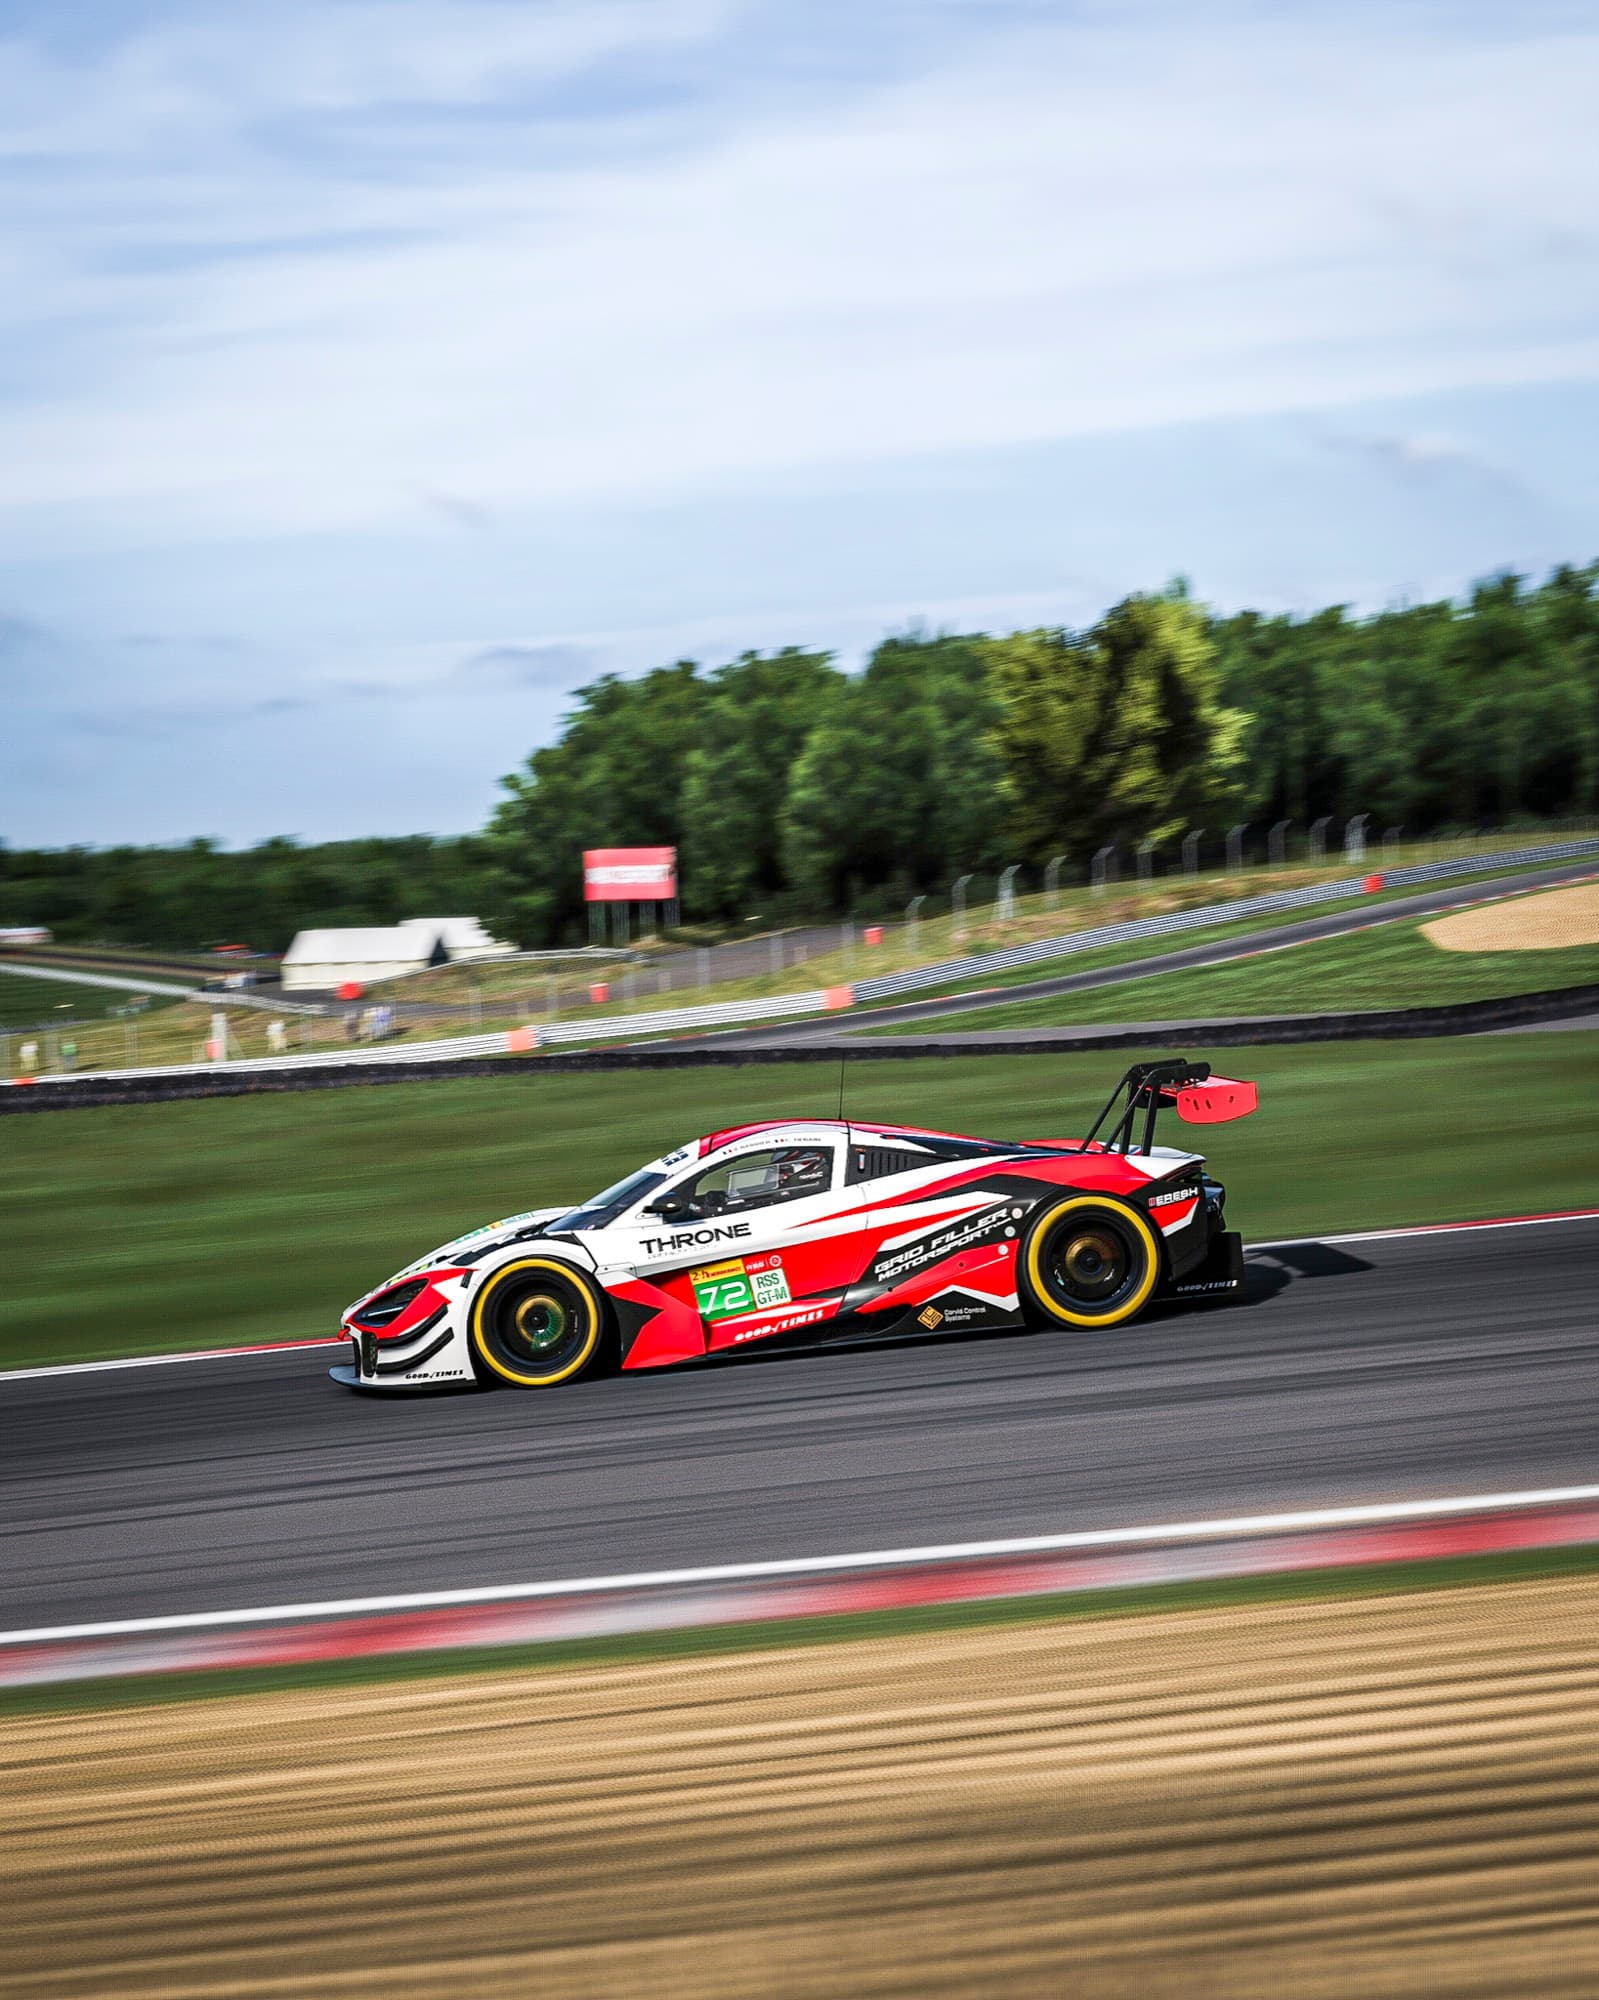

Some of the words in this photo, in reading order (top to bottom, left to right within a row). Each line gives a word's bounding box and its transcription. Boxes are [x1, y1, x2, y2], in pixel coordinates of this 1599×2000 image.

[639, 1222, 752, 1254] THRONE
[875, 1245, 924, 1274] GRID
[931, 1208, 1008, 1249] FILLER
[878, 1225, 994, 1282] MOTORSPORT
[756, 1272, 780, 1288] RSS
[757, 1286, 788, 1305] GT-M
[699, 1281, 750, 1315] 72
